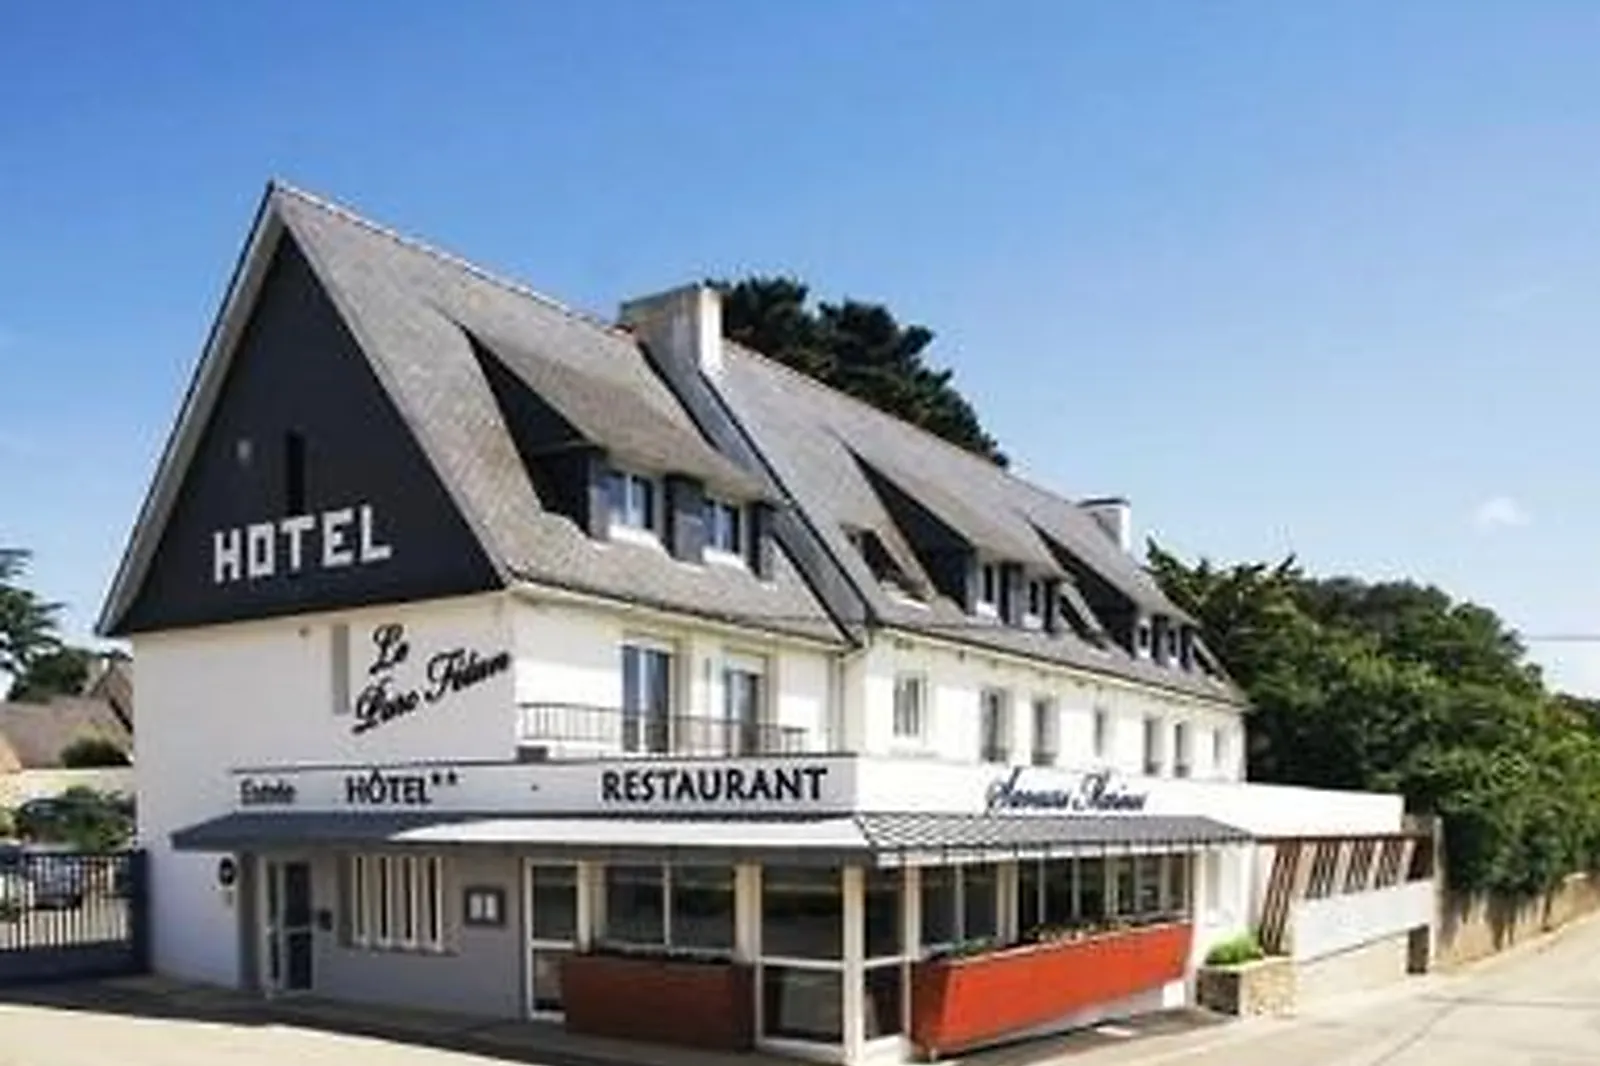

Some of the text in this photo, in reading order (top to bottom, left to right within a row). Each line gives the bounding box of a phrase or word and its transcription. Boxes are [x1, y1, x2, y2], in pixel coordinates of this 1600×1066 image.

[213, 504, 392, 584] HOTEL
[367, 623, 409, 675] Le
[601, 767, 828, 801] RESTAURANT
